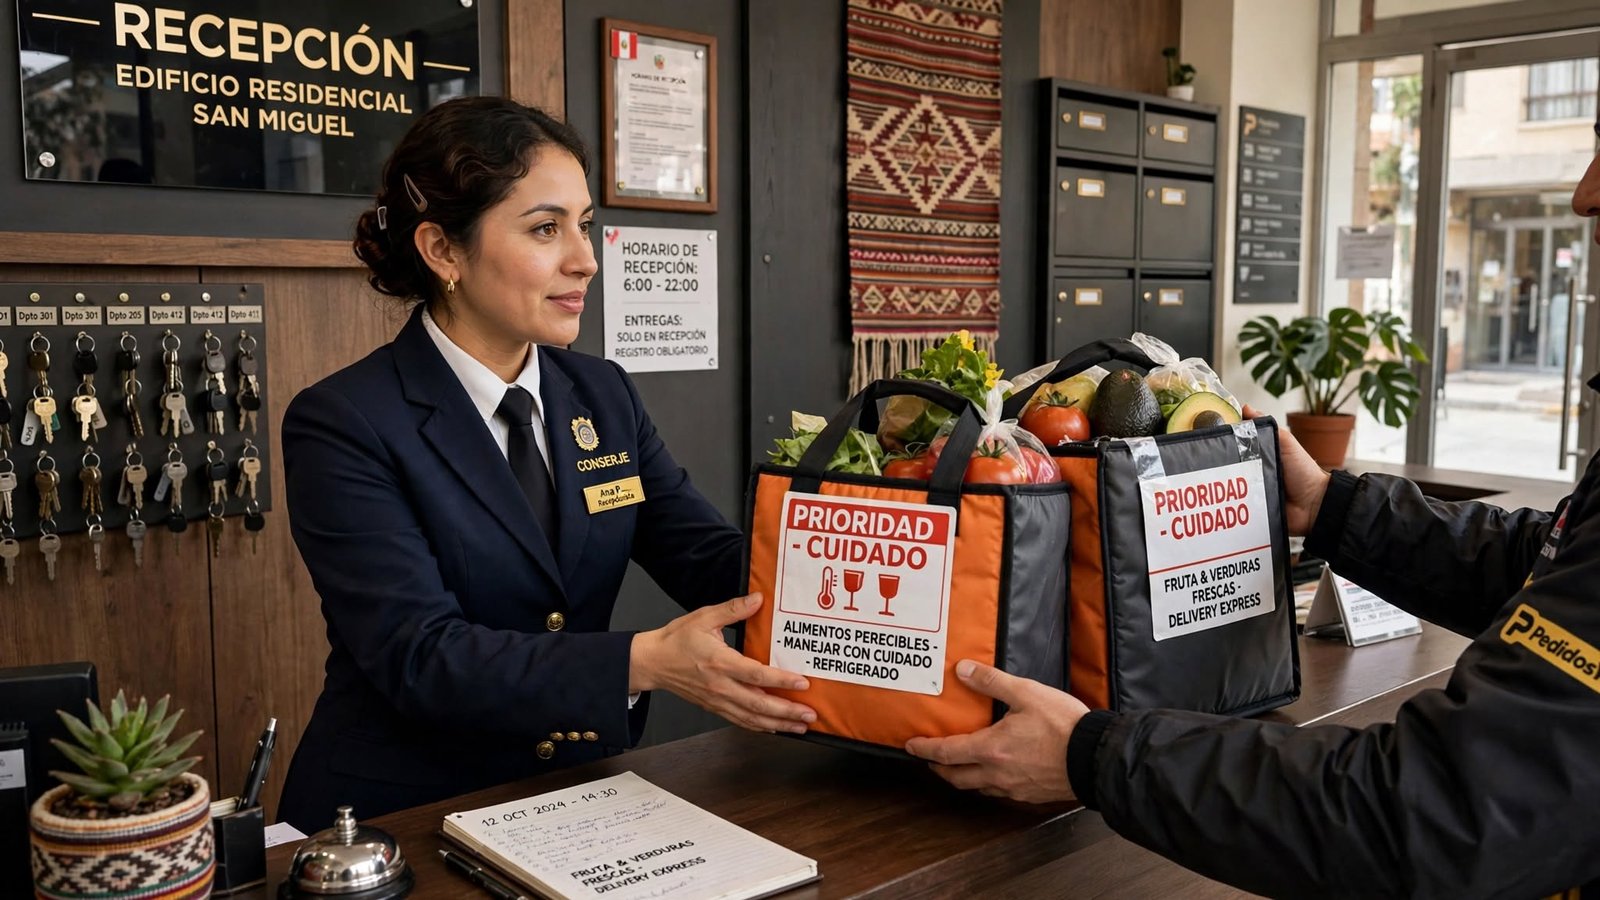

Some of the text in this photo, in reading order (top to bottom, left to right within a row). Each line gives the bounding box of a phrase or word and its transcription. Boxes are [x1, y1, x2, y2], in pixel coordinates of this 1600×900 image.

[114, 2, 414, 81] RECEPCIÓN
[117, 64, 413, 114] EDIFICIO RESIDENCIAL
[194, 103, 354, 137] SAN MIGUEL
[622, 243, 698, 256] HORARIO DE
[624, 258, 698, 274] RECEPCIÓN:
[624, 279, 652, 291] 6:00
[665, 279, 698, 291] 22:00
[19, 312, 53, 322] Dpto 301
[65, 311, 98, 321] Dpto 301
[110, 311, 141, 320] Dpto 205
[152, 310, 182, 320] Dpto 412
[211, 310, 223, 318] 412
[625, 315, 682, 326] ENTREGAS:
[617, 329, 706, 342] SOLO EN RECEPCIÓN
[615, 346, 708, 357] REGISTRO OBLIGATORIO
[577, 451, 630, 472] CONSERJE
[600, 488, 614, 497] Ana
[1155, 477, 1248, 515] PRIORIDAD
[793, 505, 934, 540] PRIORIDAD
[1171, 503, 1249, 540] CUIDADO
[807, 536, 927, 570] CUIDADO
[1164, 557, 1260, 593] FRUTA & VERDURAS
[1192, 581, 1235, 604] FRESCAS
[1169, 593, 1261, 628] DELIVERY EXPRESS
[784, 620, 851, 641] ALIMENTOS
[855, 630, 929, 651] PERECIBLES
[784, 636, 840, 656] MANEJAR
[844, 646, 870, 660] CON
[874, 651, 932, 669] CUIDADO
[813, 658, 899, 680] REFRIGERADO
[482, 817, 498, 827] 12
[503, 810, 528, 822] OCT
[533, 801, 567, 815] 2024
[581, 787, 618, 802] 14:30
[571, 864, 613, 879] FRUTA
[616, 859, 628, 867] &
[629, 840, 695, 863] VERDURAS
[582, 866, 635, 887] FRESCAS
[594, 872, 650, 894] DELIVERY
[653, 856, 706, 877] EXPRESS
